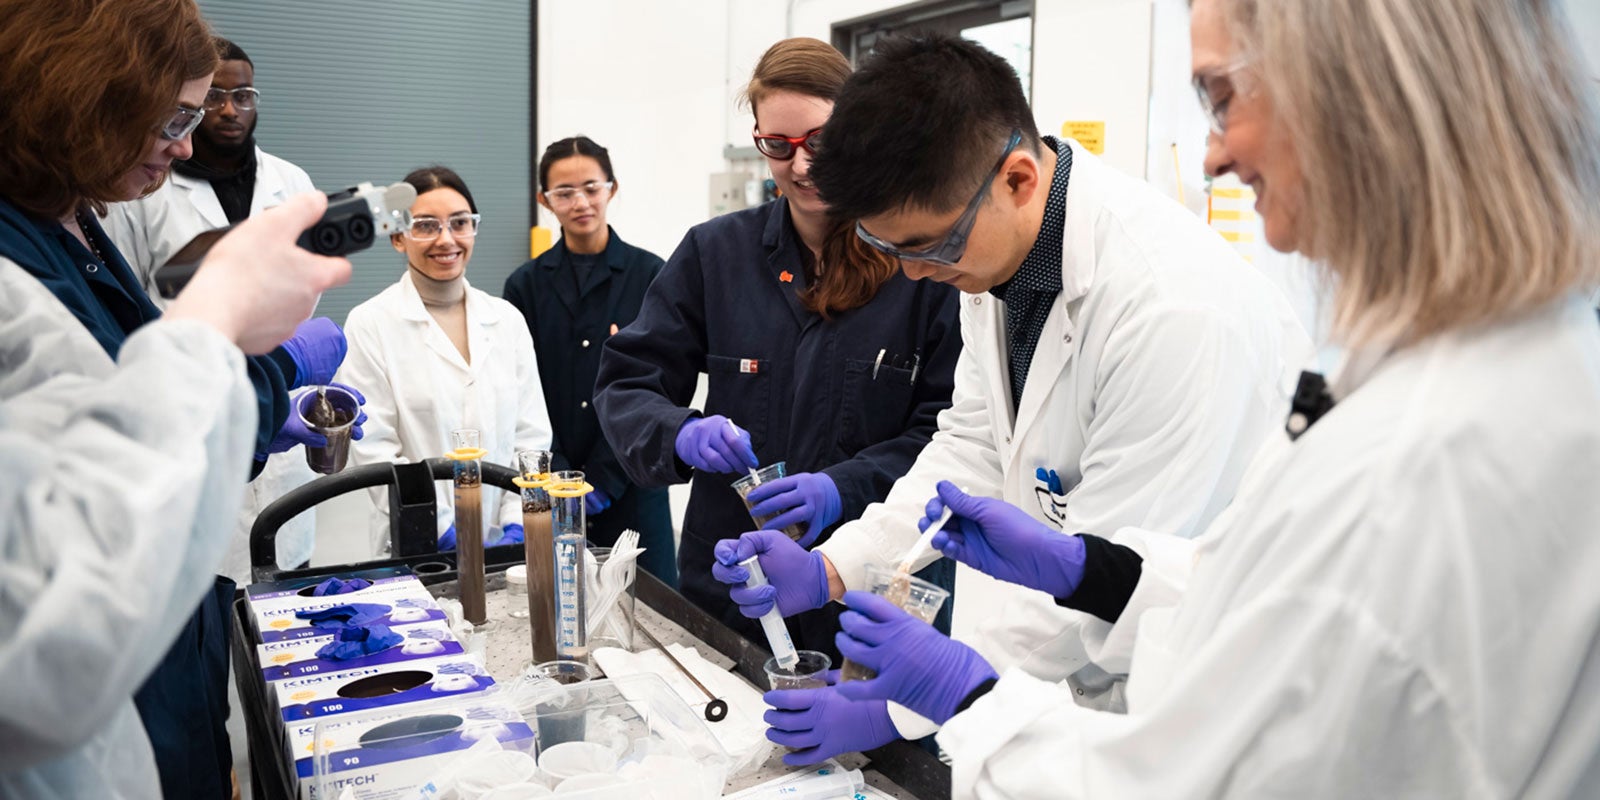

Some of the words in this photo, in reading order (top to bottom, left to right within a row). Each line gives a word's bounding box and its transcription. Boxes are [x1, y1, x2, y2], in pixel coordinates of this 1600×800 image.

[264, 636, 334, 650] KIMTEC
[300, 665, 319, 673] 100
[283, 668, 378, 688] KIMTECH
[322, 704, 343, 712] 100
[343, 756, 360, 766] 90
